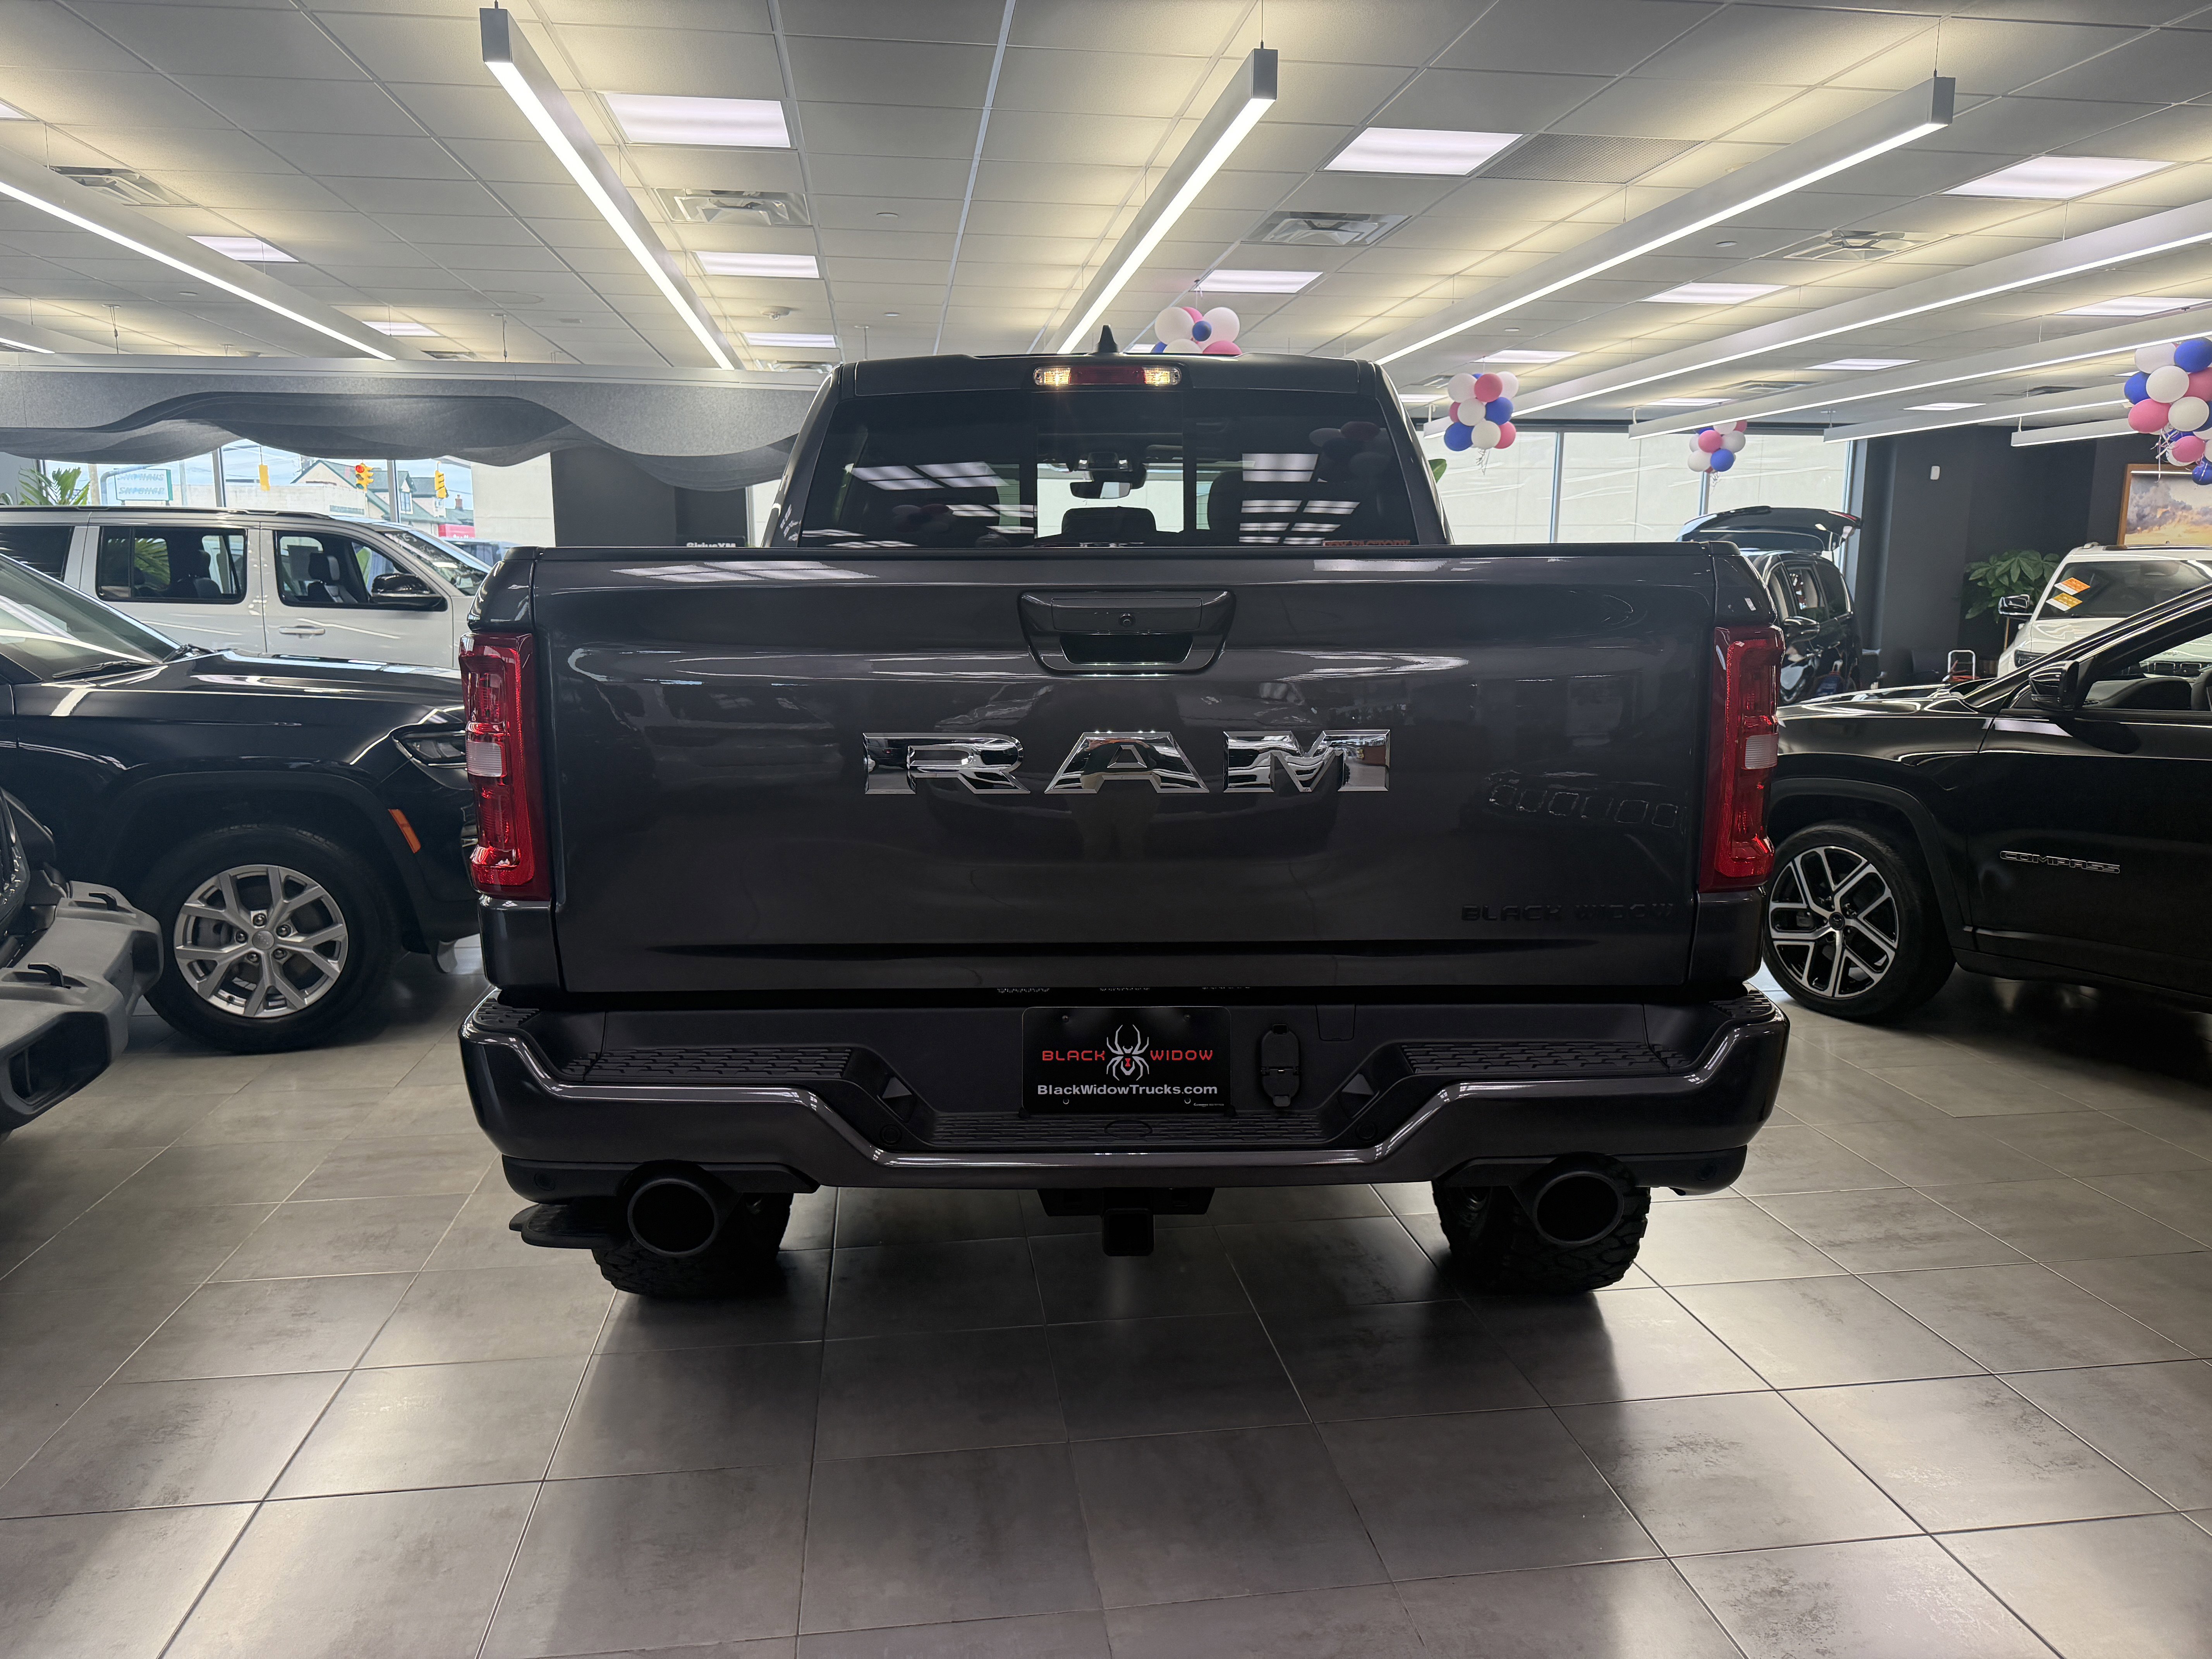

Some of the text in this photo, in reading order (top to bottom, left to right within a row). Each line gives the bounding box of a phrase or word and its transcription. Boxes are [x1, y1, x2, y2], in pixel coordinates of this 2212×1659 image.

[863, 729, 1391, 794] RAM
[1999, 850, 2120, 874] COMPASS
[1461, 903, 1674, 922] BLACK WIDOW
[1042, 1049, 1213, 1061] BLACK WIDOW
[1037, 1084, 1218, 1096] BlackWidowTrucks.com
